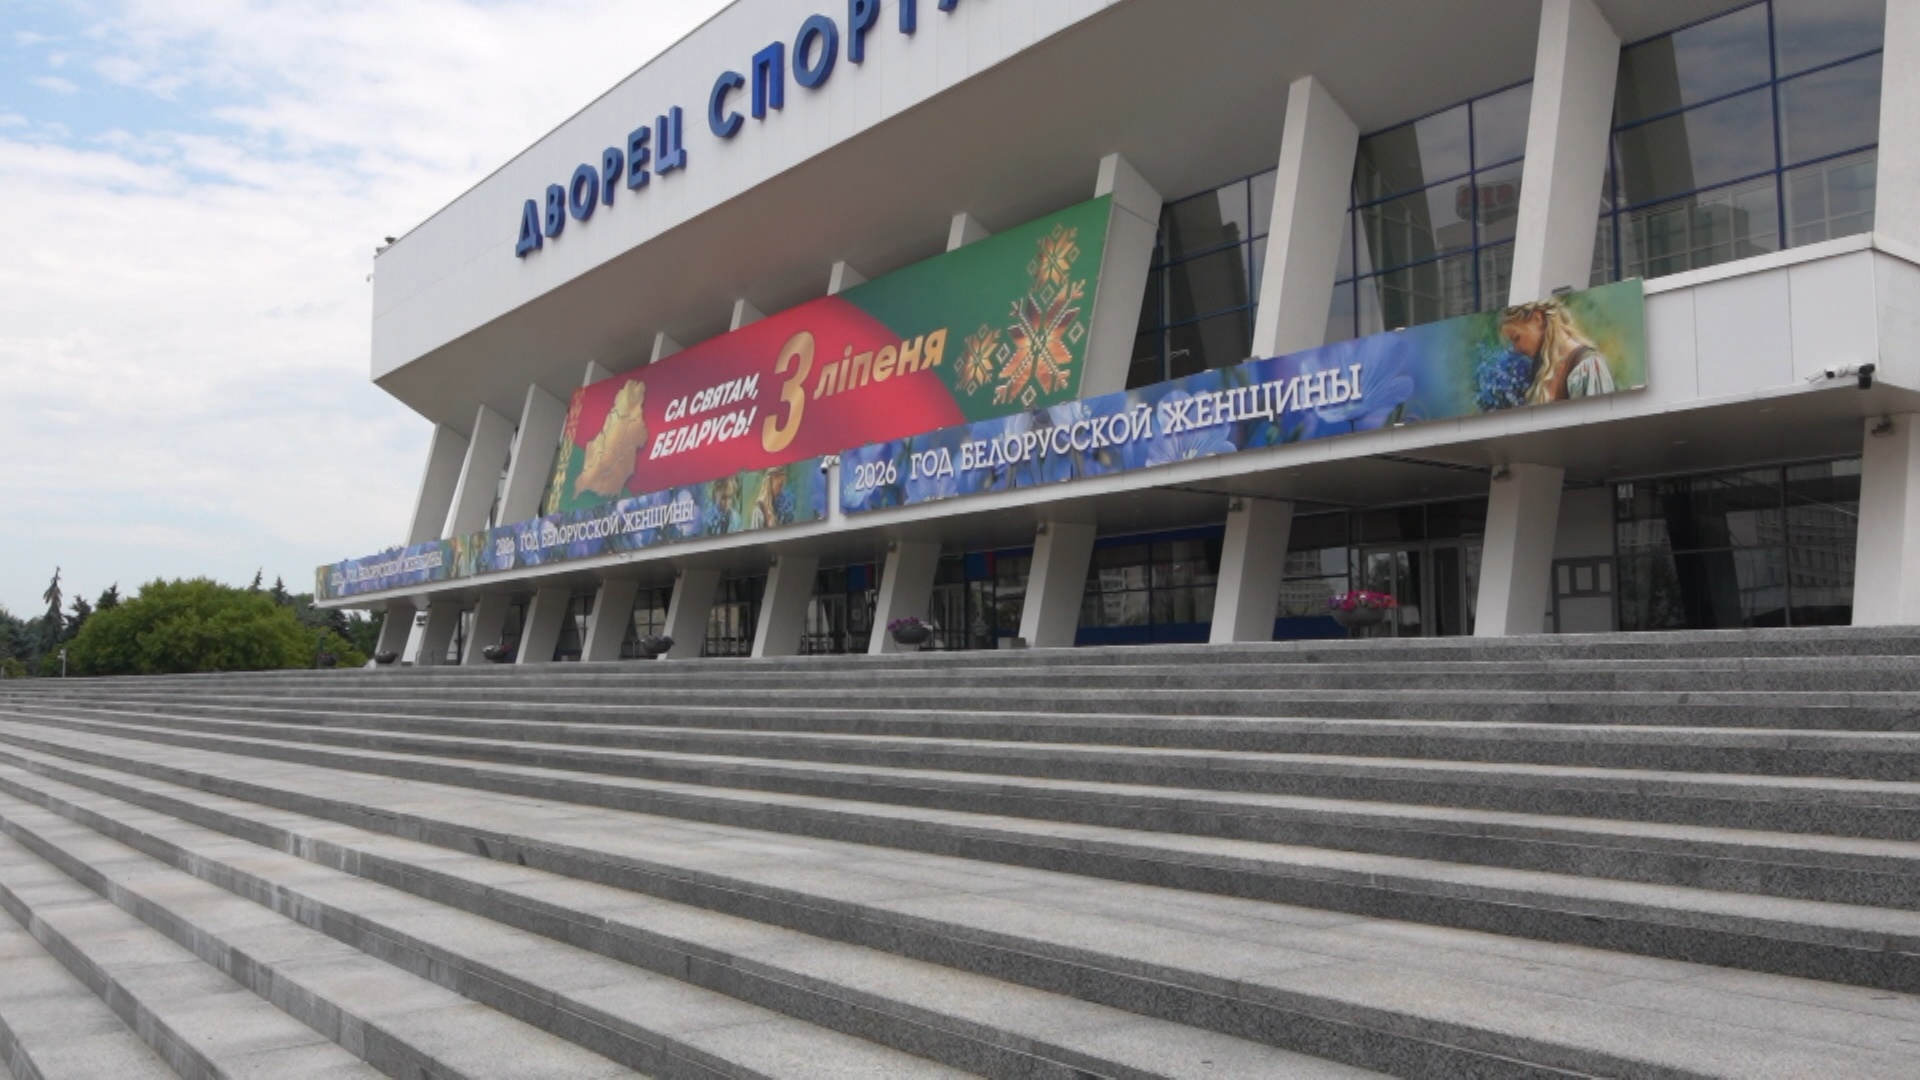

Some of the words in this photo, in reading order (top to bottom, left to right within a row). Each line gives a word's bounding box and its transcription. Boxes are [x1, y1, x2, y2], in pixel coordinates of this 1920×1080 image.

[515, 105, 687, 258] ДВОРЕЦ
[708, 0, 958, 139] СПОР
[649, 405, 758, 460] БЕЛАРУСЬ!
[664, 395, 688, 422] СА
[689, 372, 760, 416] СВЯТАМ,
[761, 331, 815, 453] 3
[813, 328, 948, 401] ліпеня
[854, 458, 898, 492] 2026
[909, 452, 955, 482] ГОД
[959, 403, 1155, 472] БЕЛОРУССКОЙ
[1161, 362, 1363, 435] ЖЕНЩИНЫ
[541, 513, 620, 548] БЕЛОРУССКОЙ
[621, 498, 695, 532] ЖЕНЩИНЫ
